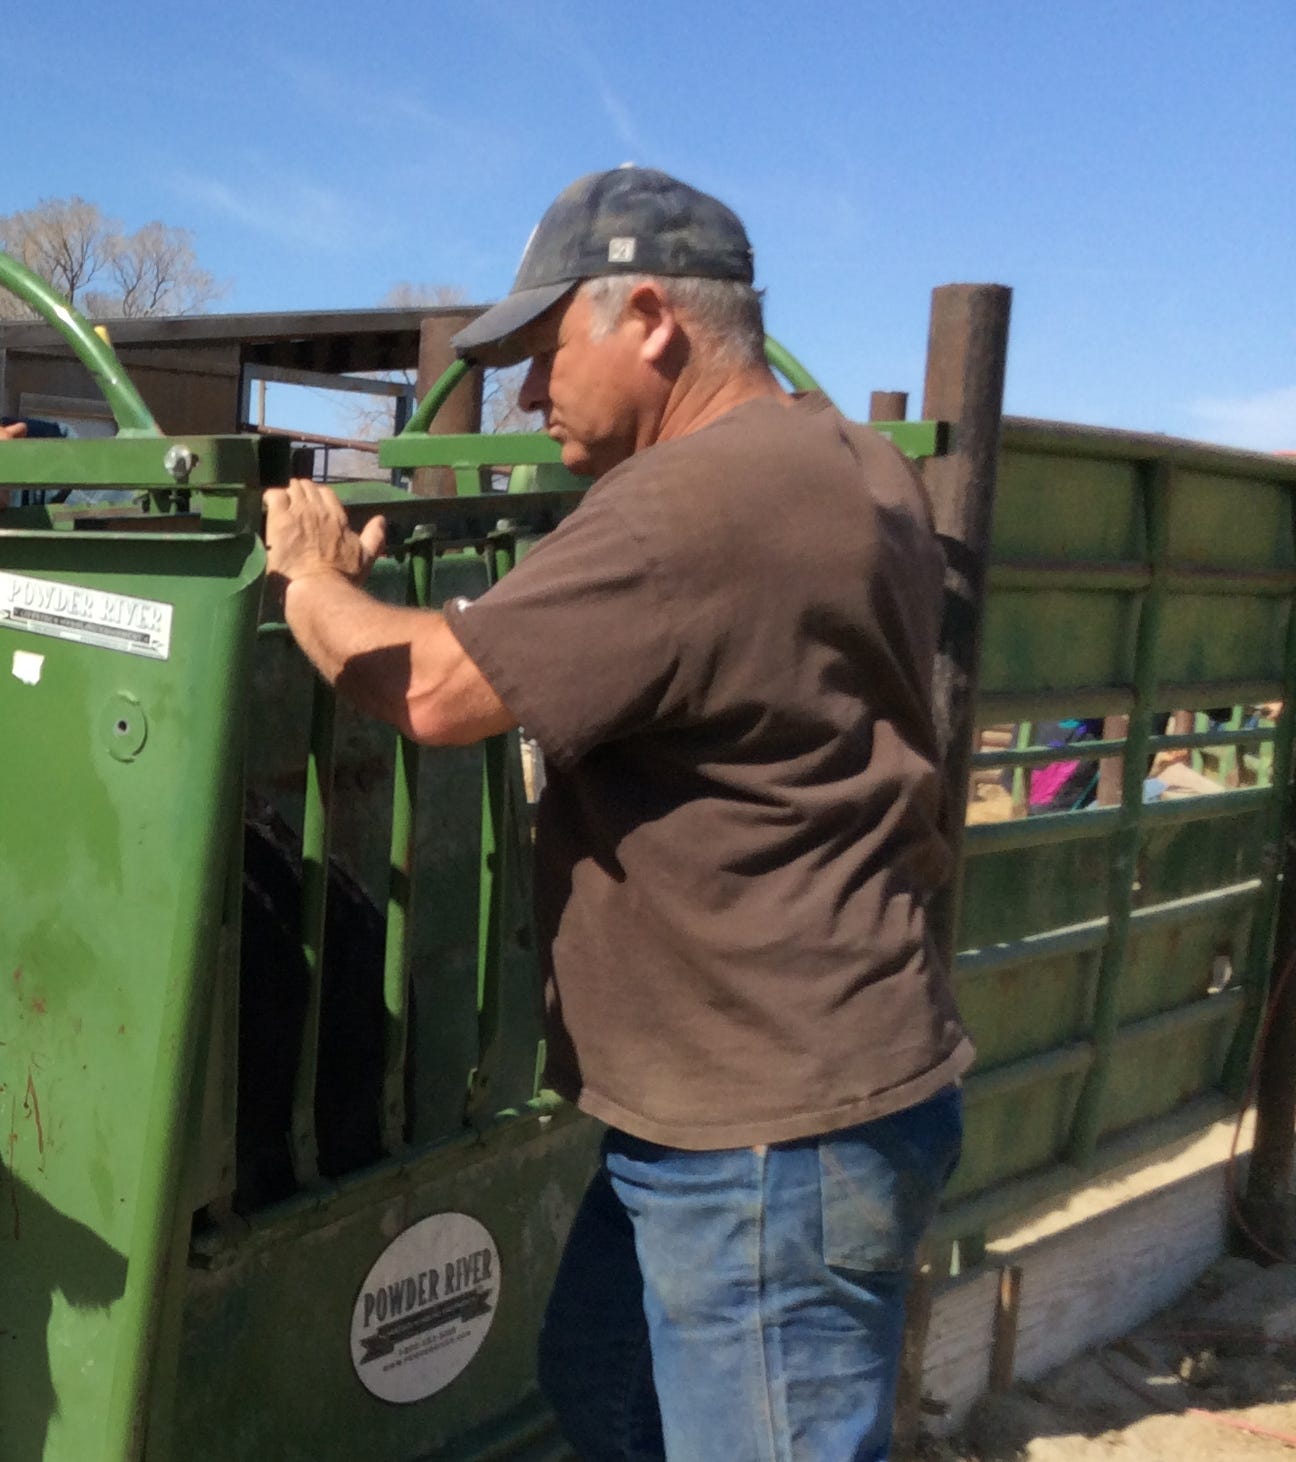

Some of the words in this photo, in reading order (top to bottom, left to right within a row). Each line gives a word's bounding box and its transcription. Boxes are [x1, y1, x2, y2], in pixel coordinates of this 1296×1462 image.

[8, 578, 95, 619] POWDER
[102, 599, 162, 633] RIVER
[363, 1268, 440, 1328] POWDER
[445, 1248, 492, 1296] RIVER
